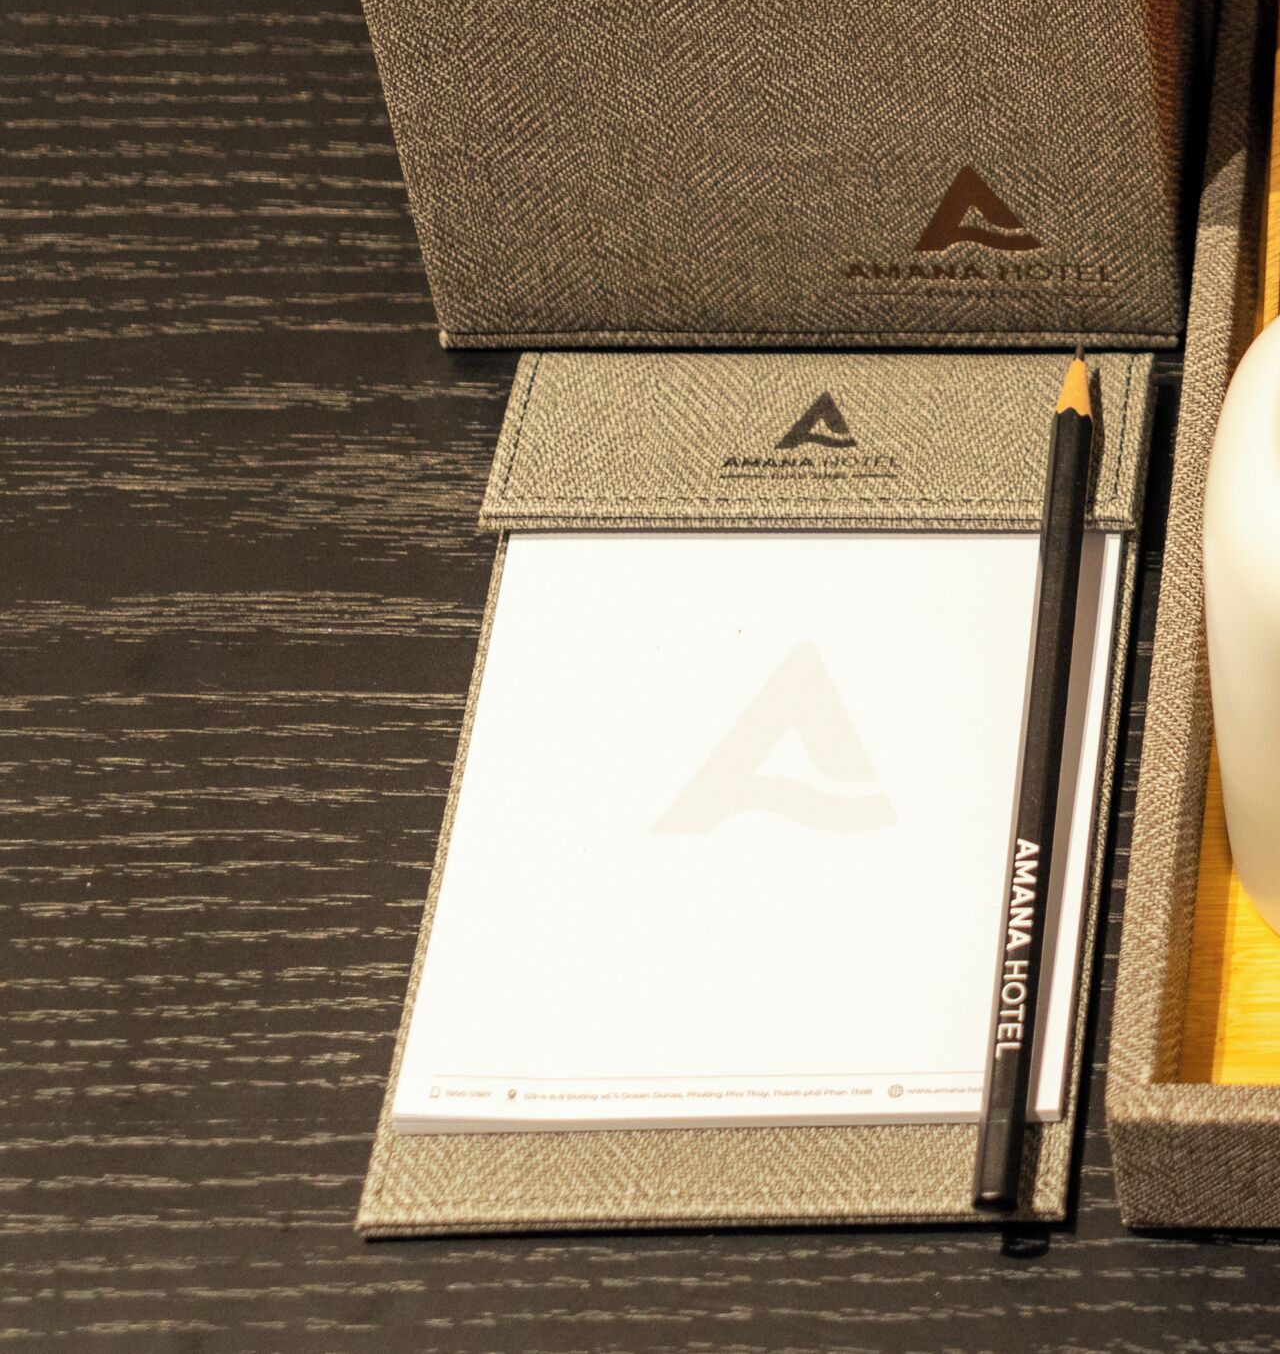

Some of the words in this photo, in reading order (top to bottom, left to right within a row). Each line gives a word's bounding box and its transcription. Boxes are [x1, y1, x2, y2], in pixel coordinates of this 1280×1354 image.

[847, 264, 988, 281] AMANA
[998, 263, 1118, 282] HOTEL
[722, 456, 815, 468] AMANA
[1006, 837, 1040, 952] AMANA
[995, 959, 1030, 1061] HOTEL
